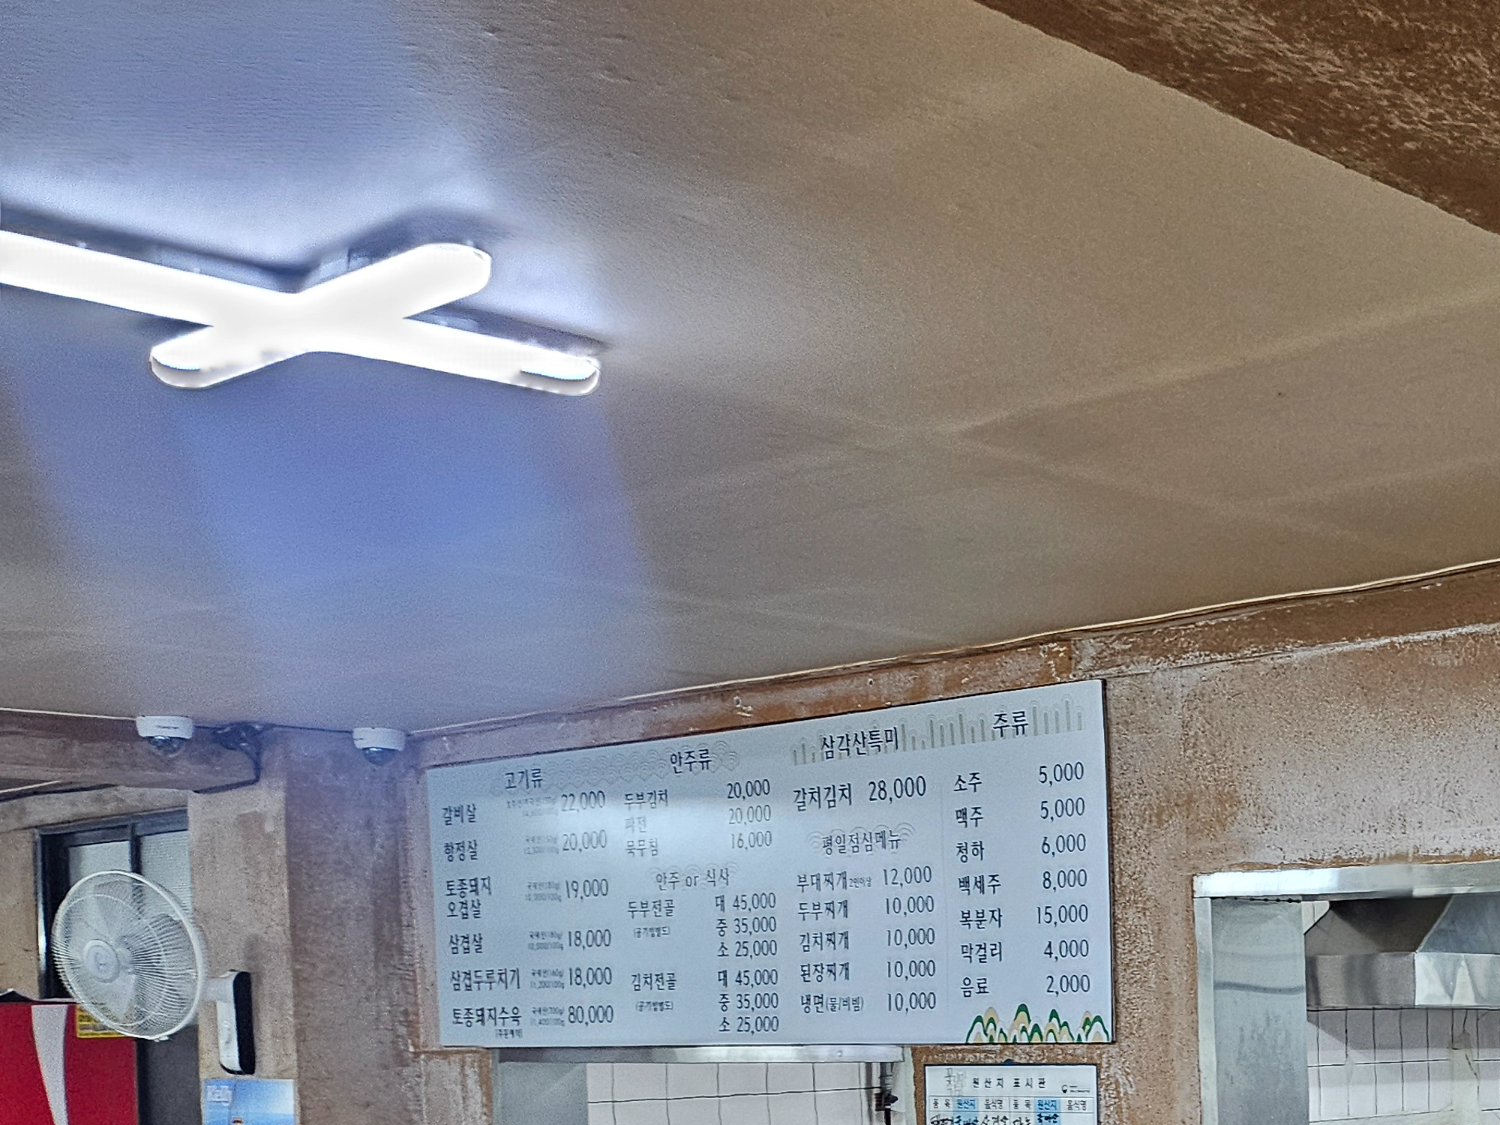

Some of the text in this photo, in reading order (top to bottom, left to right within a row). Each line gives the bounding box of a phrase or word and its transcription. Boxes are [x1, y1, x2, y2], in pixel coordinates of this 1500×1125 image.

[993, 710, 1029, 737] 주류
[821, 727, 899, 760] 삼각산특미
[670, 748, 712, 772] 안주류
[505, 768, 544, 790] 고기류
[954, 762, 1084, 794] 소주 5,000
[624, 779, 770, 808] 두부김치 20,000
[793, 776, 927, 813] 갈치김치 28,000
[442, 803, 477, 826] 갈비살
[560, 791, 606, 813] 22,000
[728, 805, 772, 825] 20,000
[955, 798, 1086, 827] 맥주 5,000
[443, 840, 478, 862] 항정살
[562, 830, 608, 852] 20,000
[730, 831, 772, 850] 16,000
[822, 829, 902, 854] 평일점심메뉴
[955, 833, 1087, 863] 청하 6,000
[445, 876, 492, 897] 토종돼지
[565, 879, 609, 901] 19,000
[655, 869, 730, 892] 안주 or 식사
[797, 871, 848, 893] 부대찌개
[882, 866, 932, 889] 12,000
[958, 869, 1088, 896] 백세주 8,000
[446, 899, 482, 920] 오겹살
[627, 893, 776, 919] 두부전골 대 45,000
[798, 895, 935, 921] 두부찌개 10,000
[959, 904, 1089, 930] 복분자 15,000
[715, 920, 728, 938] 중
[733, 917, 777, 937] 35,000
[449, 933, 484, 955] 삼겹살
[567, 929, 612, 950] 18,000
[716, 940, 778, 961] 소 25,000
[800, 928, 936, 954] 김치찌개 10,000
[961, 939, 1090, 963] 막걸리 4,000
[450, 968, 521, 991] 삼겹두루치기
[568, 967, 612, 990] 18,000
[631, 969, 778, 991] 김치전골 대 45,000
[801, 959, 936, 982] 된장찌개 10,000
[960, 975, 1091, 998] 음료 2,000
[718, 994, 730, 1012] 중
[736, 993, 779, 1012] 35,000
[887, 992, 937, 1014] 10,000
[452, 1006, 522, 1027] 토종돼지수육
[568, 1005, 614, 1026] 80,000
[719, 1015, 780, 1036] 소 25,000
